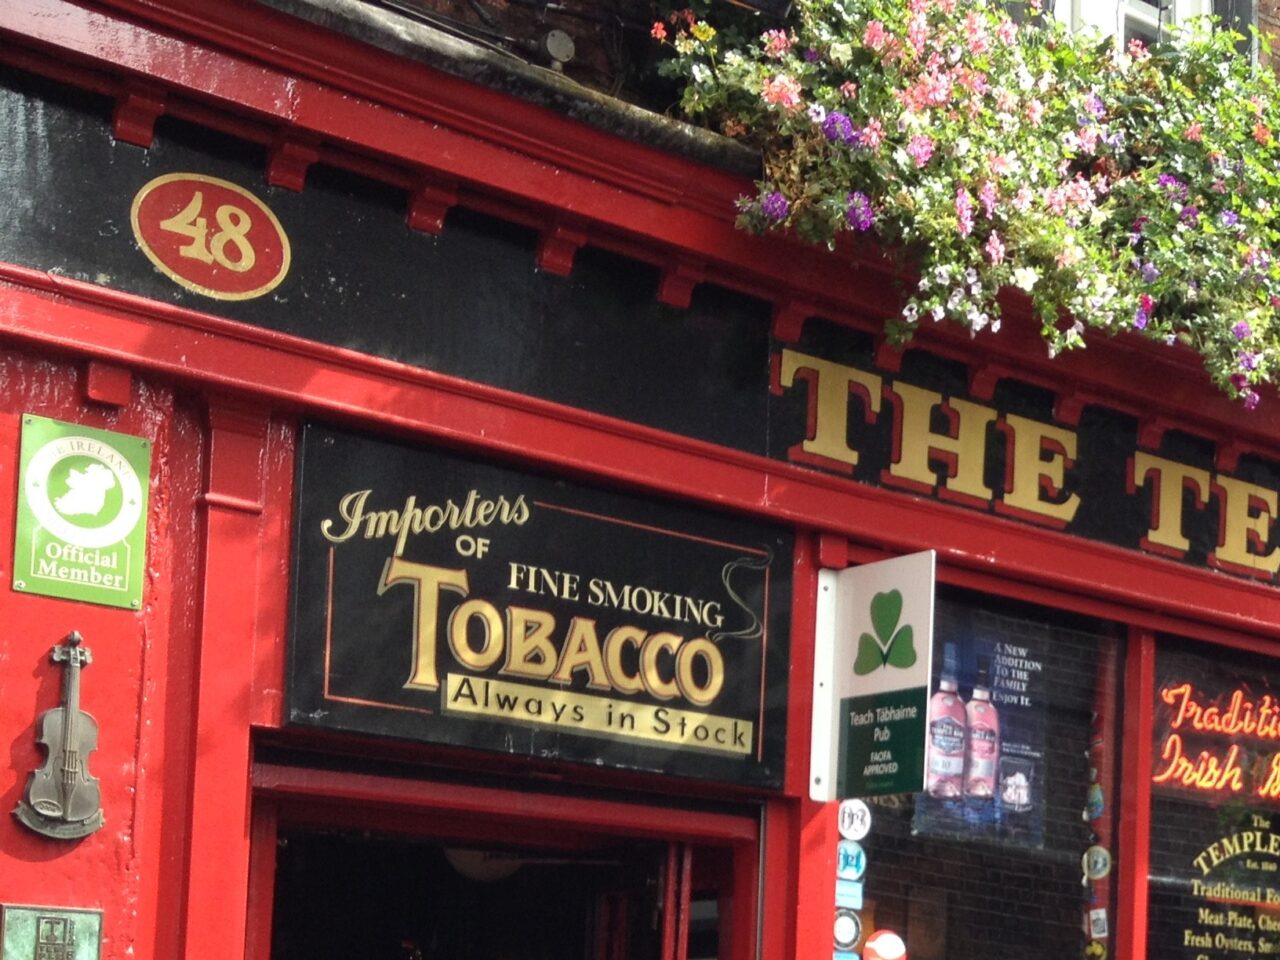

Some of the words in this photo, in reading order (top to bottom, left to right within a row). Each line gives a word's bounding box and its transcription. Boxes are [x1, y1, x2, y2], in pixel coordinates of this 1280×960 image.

[159, 190, 257, 273] 48
[772, 348, 1081, 527] THE
[320, 489, 530, 556] Importers
[45, 542, 118, 569] Official
[455, 533, 490, 560] OF
[38, 558, 123, 587] Member
[507, 562, 581, 602] FINE
[588, 579, 724, 628] SMOKING
[377, 556, 725, 706] TOBACCO
[995, 655, 1042, 671] ADDITION
[1004, 644, 1029, 657] NEW
[993, 677, 1028, 692] FAMILY
[995, 664, 1008, 677] TO
[1011, 669, 1029, 681] THE
[452, 677, 585, 724] Always
[607, 703, 635, 731] in
[653, 710, 747, 748] Stock
[850, 709, 874, 726] Teach
[874, 726, 890, 742] Pub
[863, 762, 898, 776] APPROVED
[1152, 734, 1243, 791] Irish
[1252, 814, 1271, 829] The
[1191, 878, 1260, 903] Traditional
[1198, 908, 1224, 924] Meat
[1184, 930, 1212, 948] Fresh
[1215, 932, 1256, 954] Oysters,
